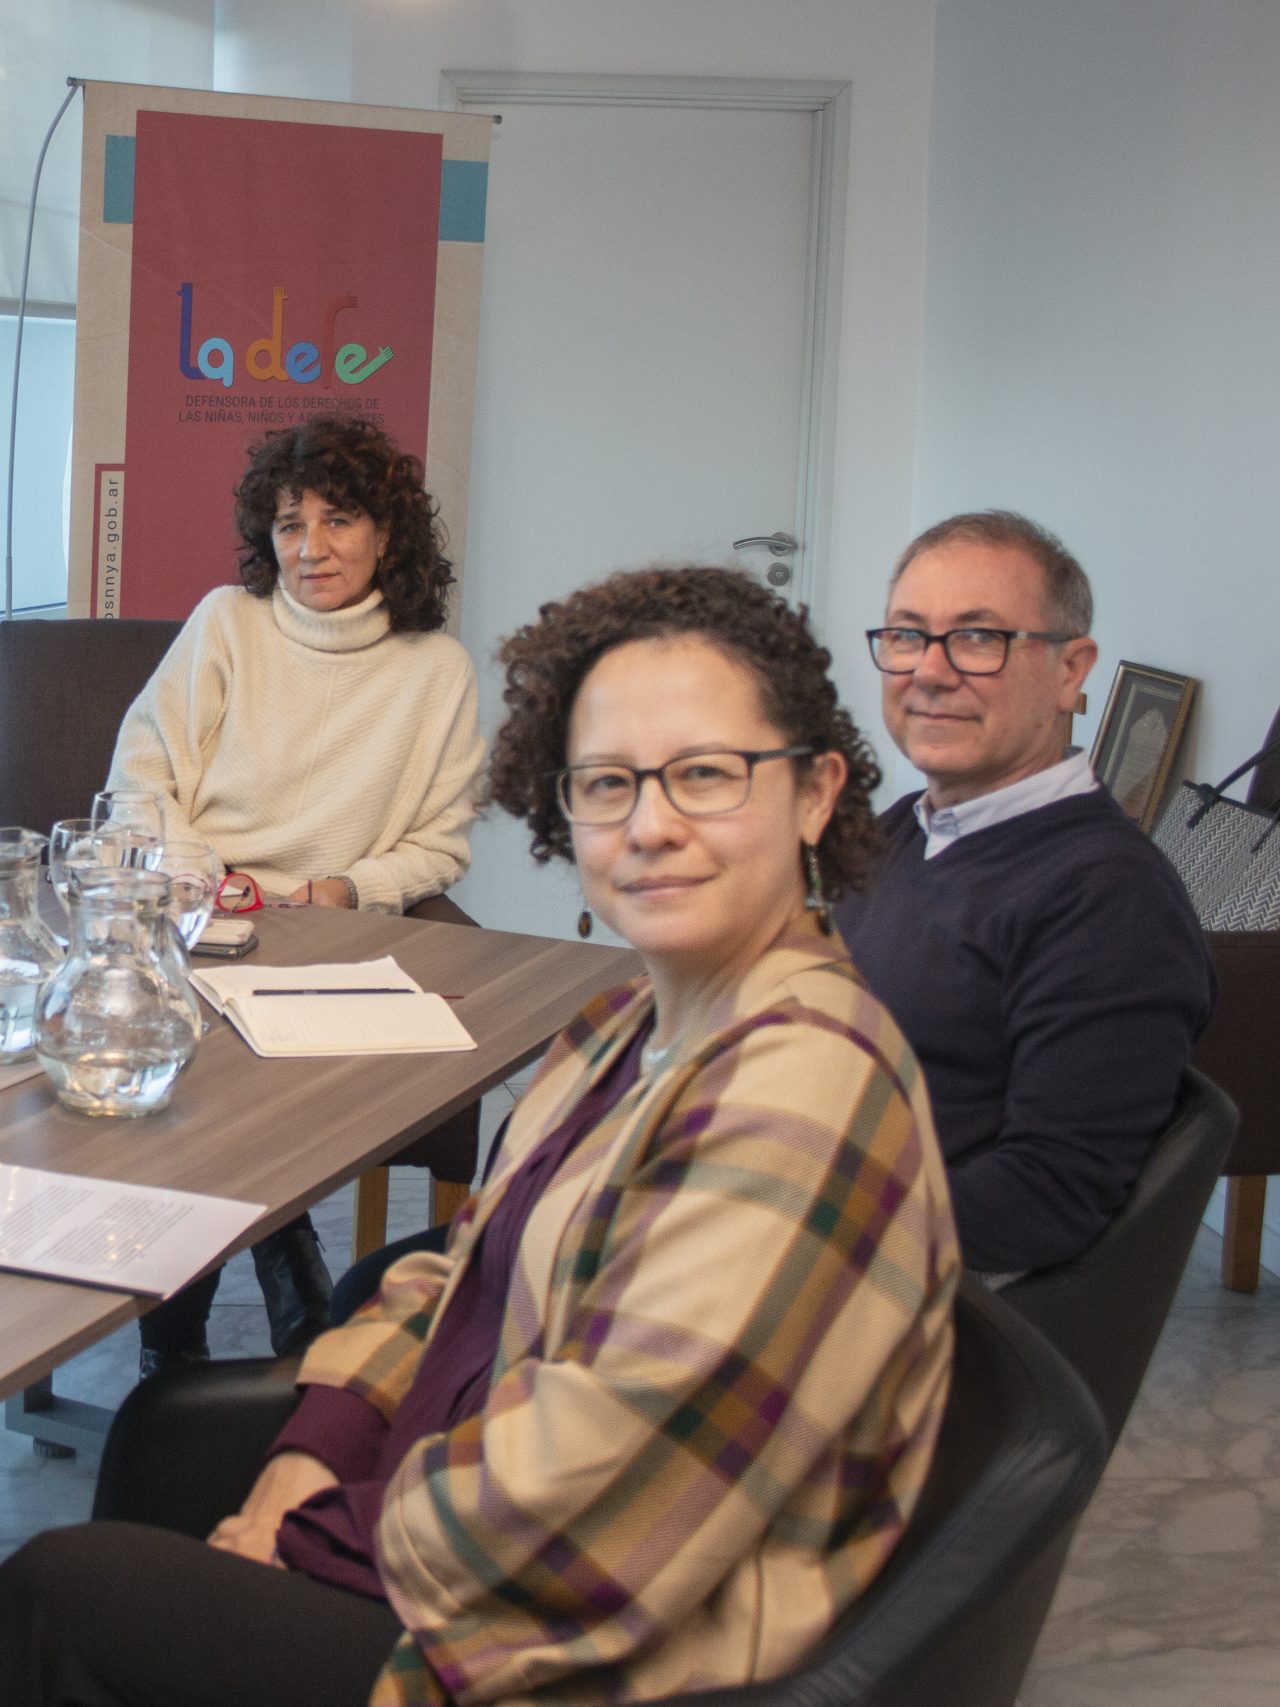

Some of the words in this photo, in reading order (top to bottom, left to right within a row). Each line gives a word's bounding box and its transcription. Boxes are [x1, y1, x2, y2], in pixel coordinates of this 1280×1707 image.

[186, 395, 256, 408] DEFENSORA
[259, 397, 274, 408] DE
[278, 397, 298, 409] LOS
[303, 397, 362, 409] DERECHOS
[365, 398, 380, 410] DE
[178, 410, 201, 423] LAS
[205, 409, 244, 424] NIÑAS,
[248, 410, 285, 424] NIÑOS
[287, 412, 295, 424] Y
